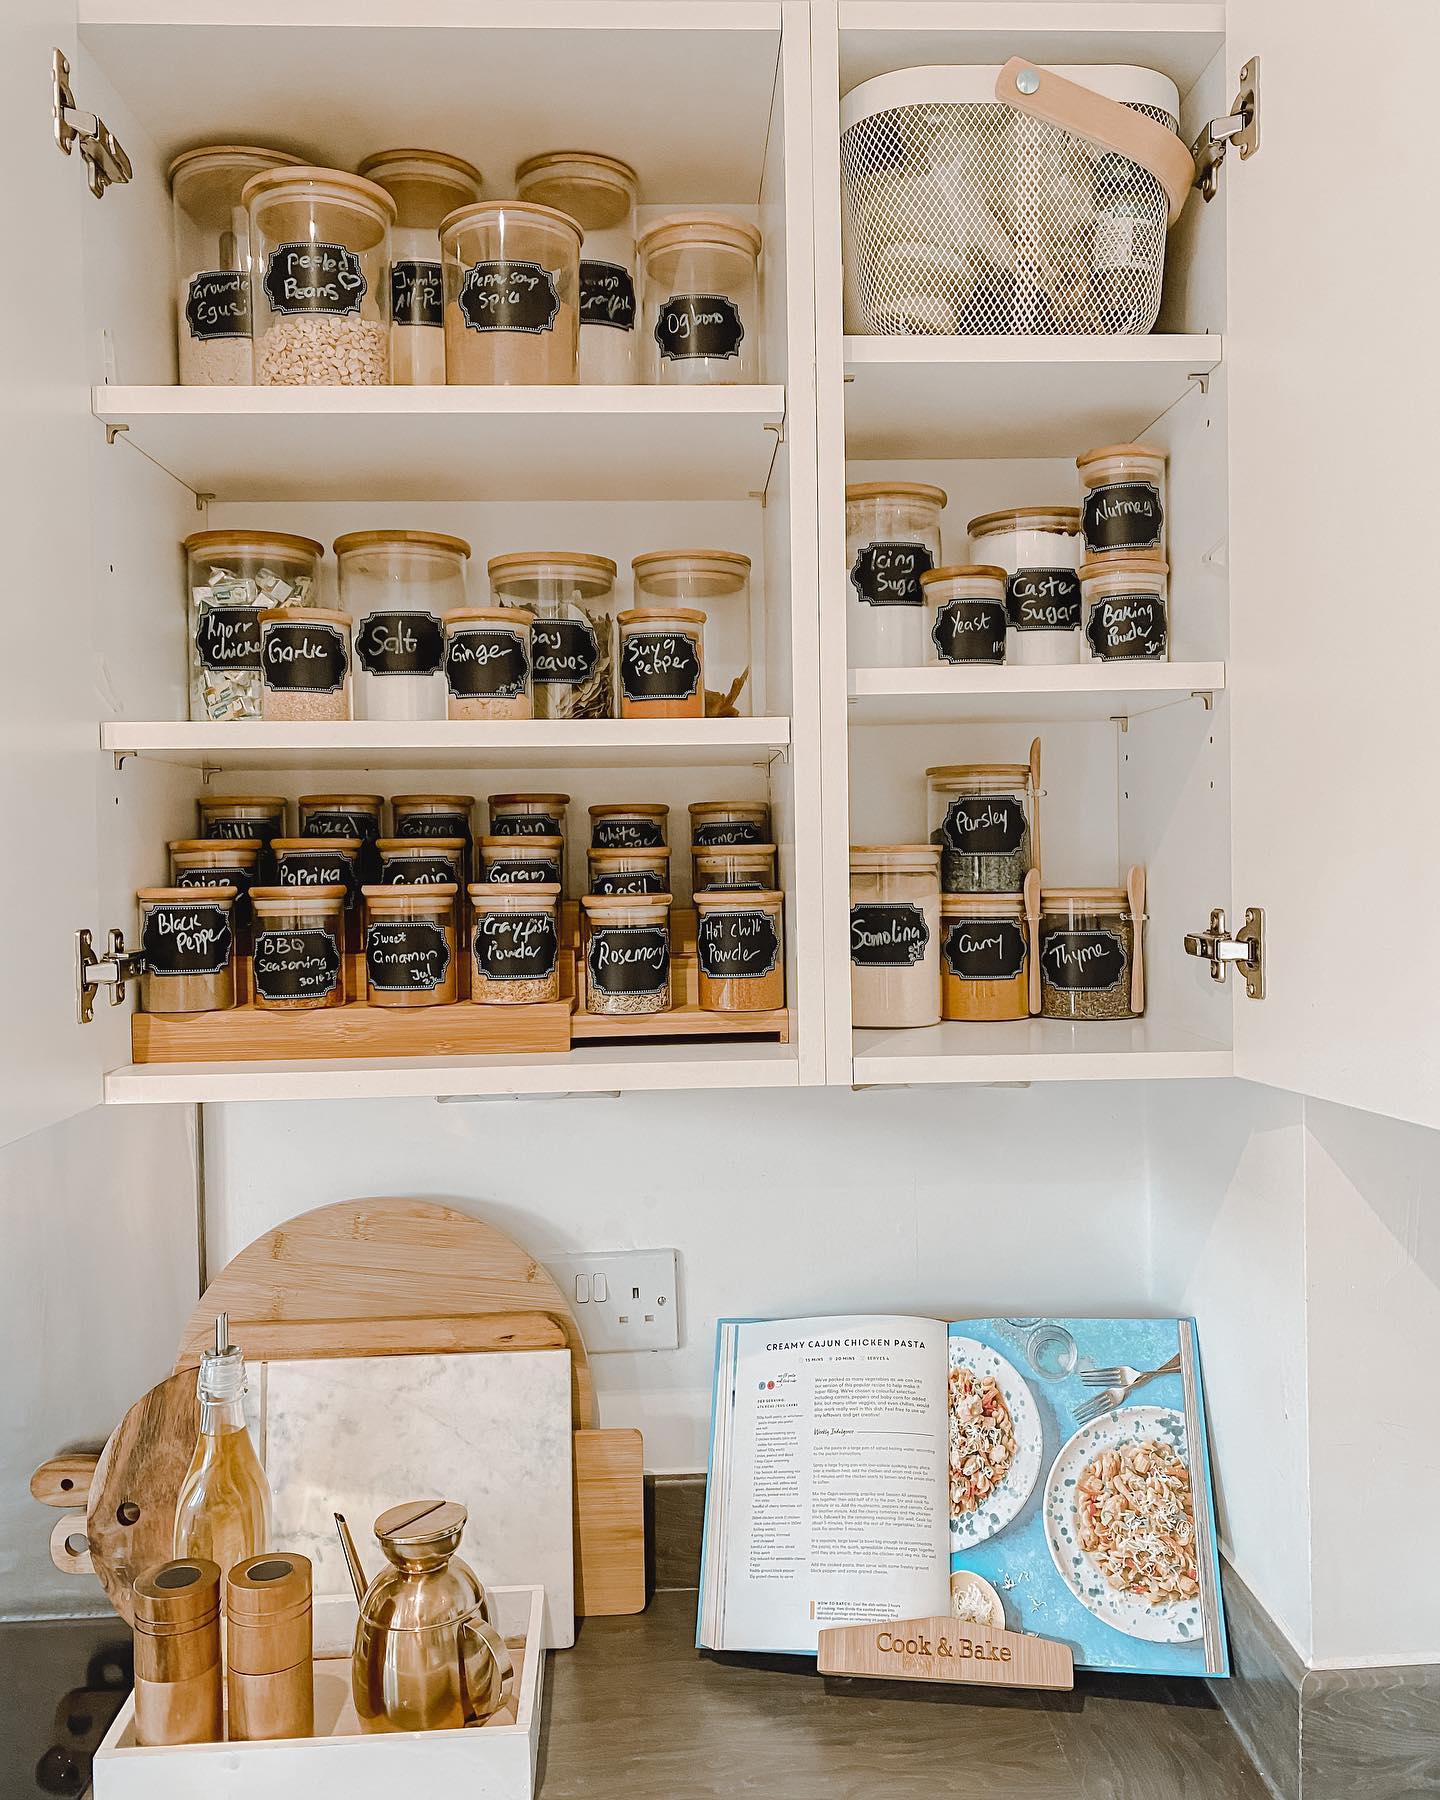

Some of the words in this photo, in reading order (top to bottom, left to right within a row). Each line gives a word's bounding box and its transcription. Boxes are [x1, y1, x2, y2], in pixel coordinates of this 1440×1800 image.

[287, 252, 348, 275] Peeled
[284, 279, 339, 300] Beans
[396, 271, 441, 288] Jumb
[197, 300, 247, 324] Egusi
[668, 304, 723, 338] Ogbono
[1095, 499, 1153, 526] Nutmeg
[870, 549, 914, 574] Icing
[1012, 577, 1076, 598] Caster
[951, 610, 991, 638] Yeast
[1021, 600, 1078, 624] Sugar
[1101, 602, 1153, 628] Baking
[207, 615, 253, 640] Knorr
[368, 620, 418, 656] Salt
[268, 638, 327, 664] Garlic
[451, 643, 513, 665] Ginger
[533, 654, 588, 671] eaves
[956, 805, 1008, 835] Parsley
[489, 865, 546, 885] Garam
[157, 913, 202, 936] Black
[483, 917, 551, 945] Crayfish
[706, 920, 723, 941] Hot
[175, 924, 228, 955] Pepper
[263, 938, 306, 955] BBQ
[372, 931, 407, 947] Sweet
[258, 956, 328, 975] Seasoning
[598, 941, 666, 970] Rosemary
[1049, 942, 1110, 973] Thyme
[766, 1341, 805, 1351] CREAMY
[808, 1339, 841, 1348] CAJUN
[844, 1338, 890, 1347] CHICKEN
[894, 1339, 926, 1349] PASTA
[876, 1632, 931, 1656] Cook
[937, 1637, 953, 1658] &
[958, 1638, 1012, 1662] Bake
